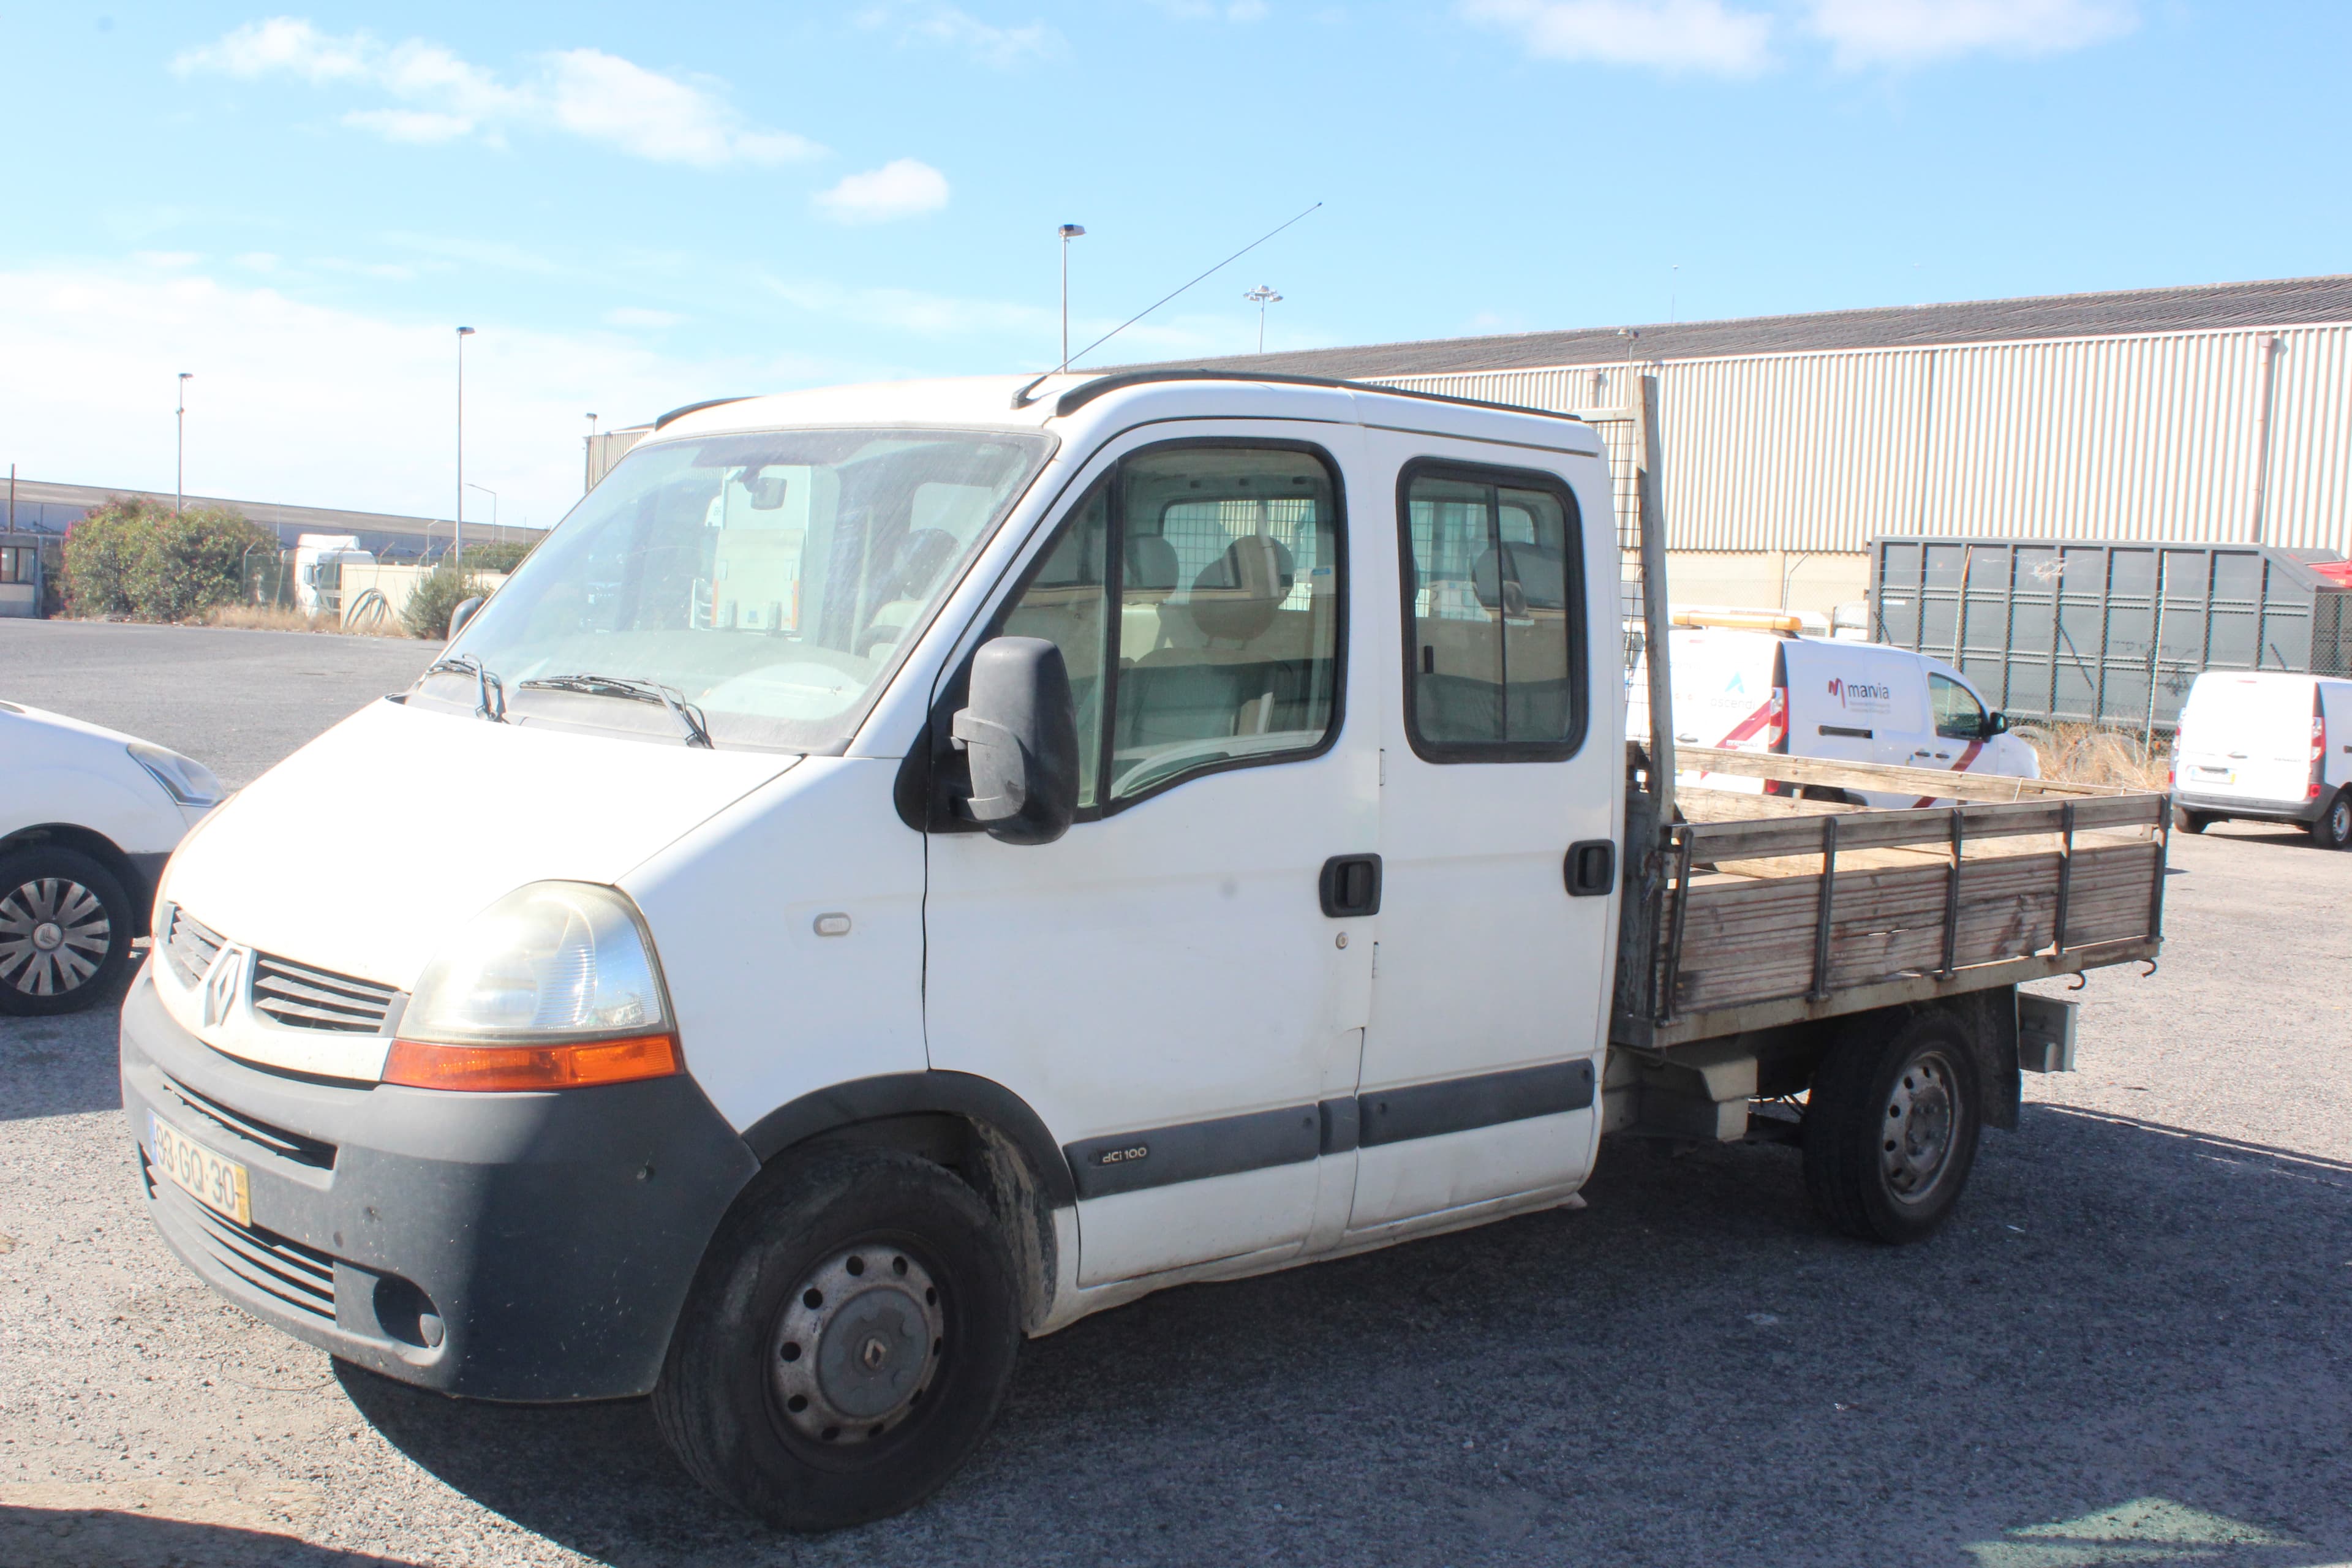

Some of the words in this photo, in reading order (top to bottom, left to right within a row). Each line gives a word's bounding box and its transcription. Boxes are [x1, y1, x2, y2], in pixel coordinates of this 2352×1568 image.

[1847, 682, 1890, 699] marvia
[1710, 698, 1755, 710] ascendi
[1102, 1151, 1122, 1163] dCi
[1125, 1147, 1147, 1159] 100
